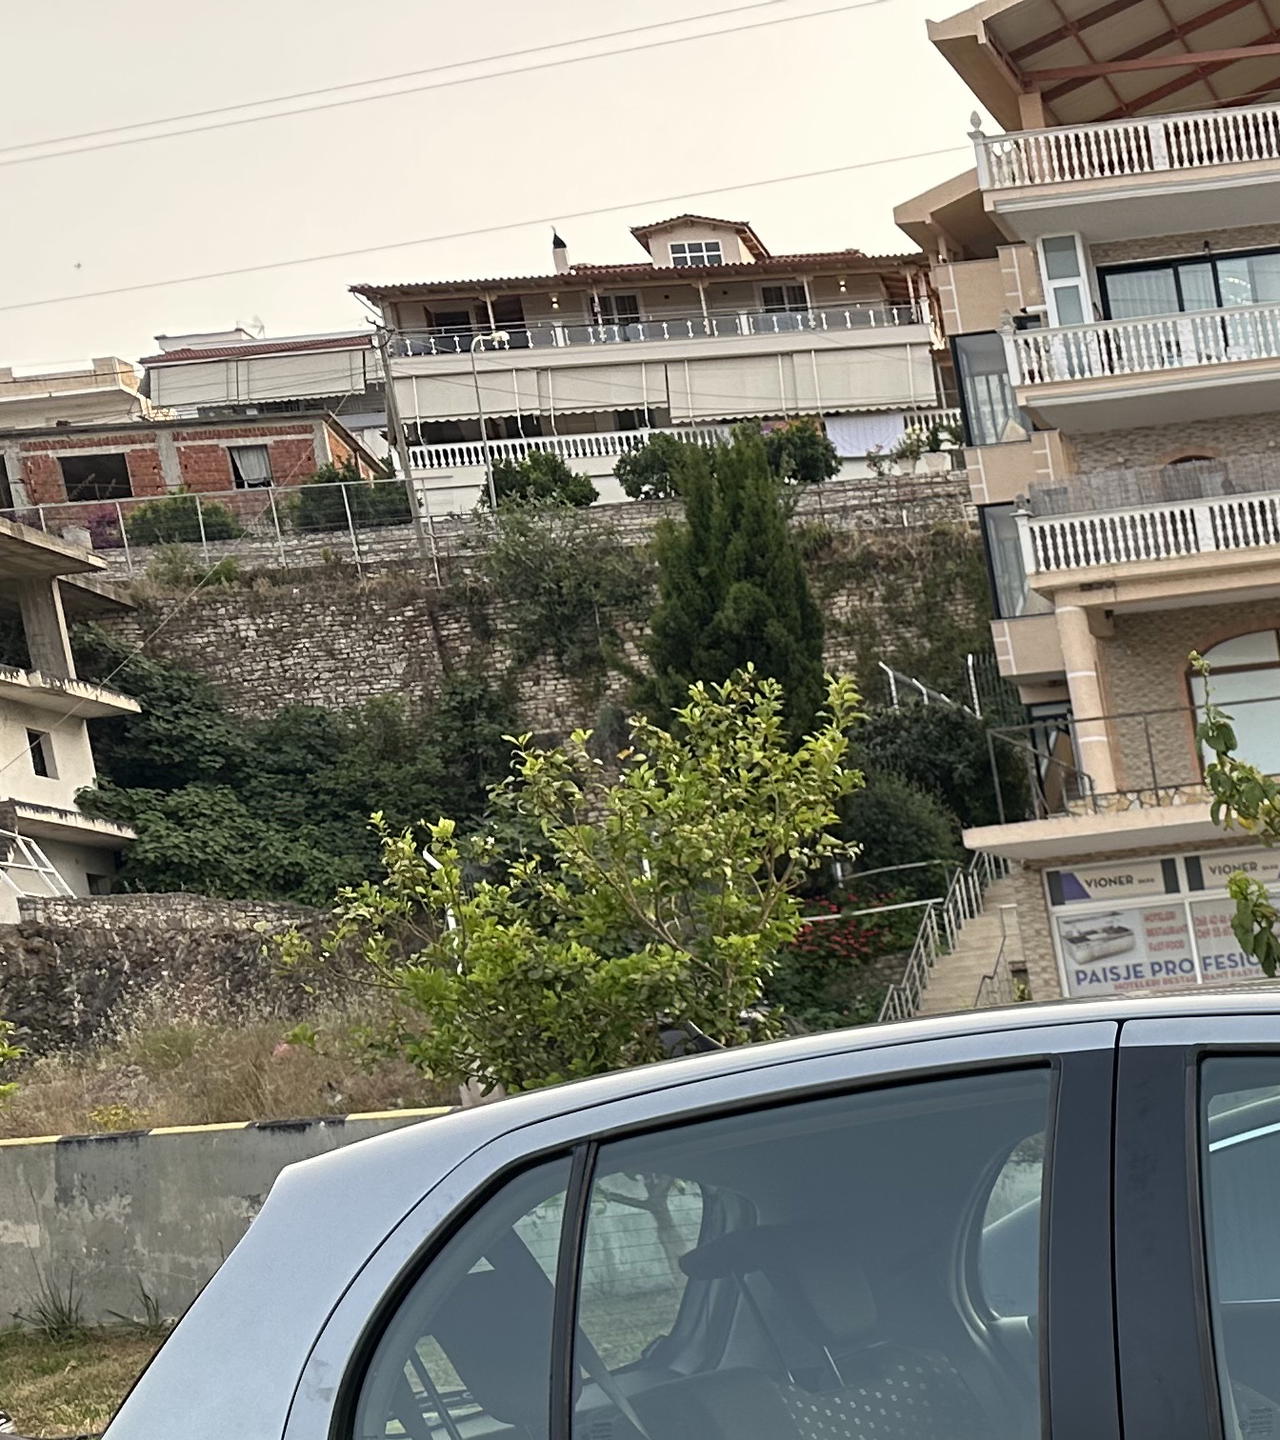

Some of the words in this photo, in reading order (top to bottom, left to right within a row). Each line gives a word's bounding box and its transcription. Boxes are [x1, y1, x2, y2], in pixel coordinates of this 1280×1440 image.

[1208, 861, 1258, 875] VIONER
[1084, 874, 1134, 888] VIONER
[1075, 963, 1145, 985] PAISJE
